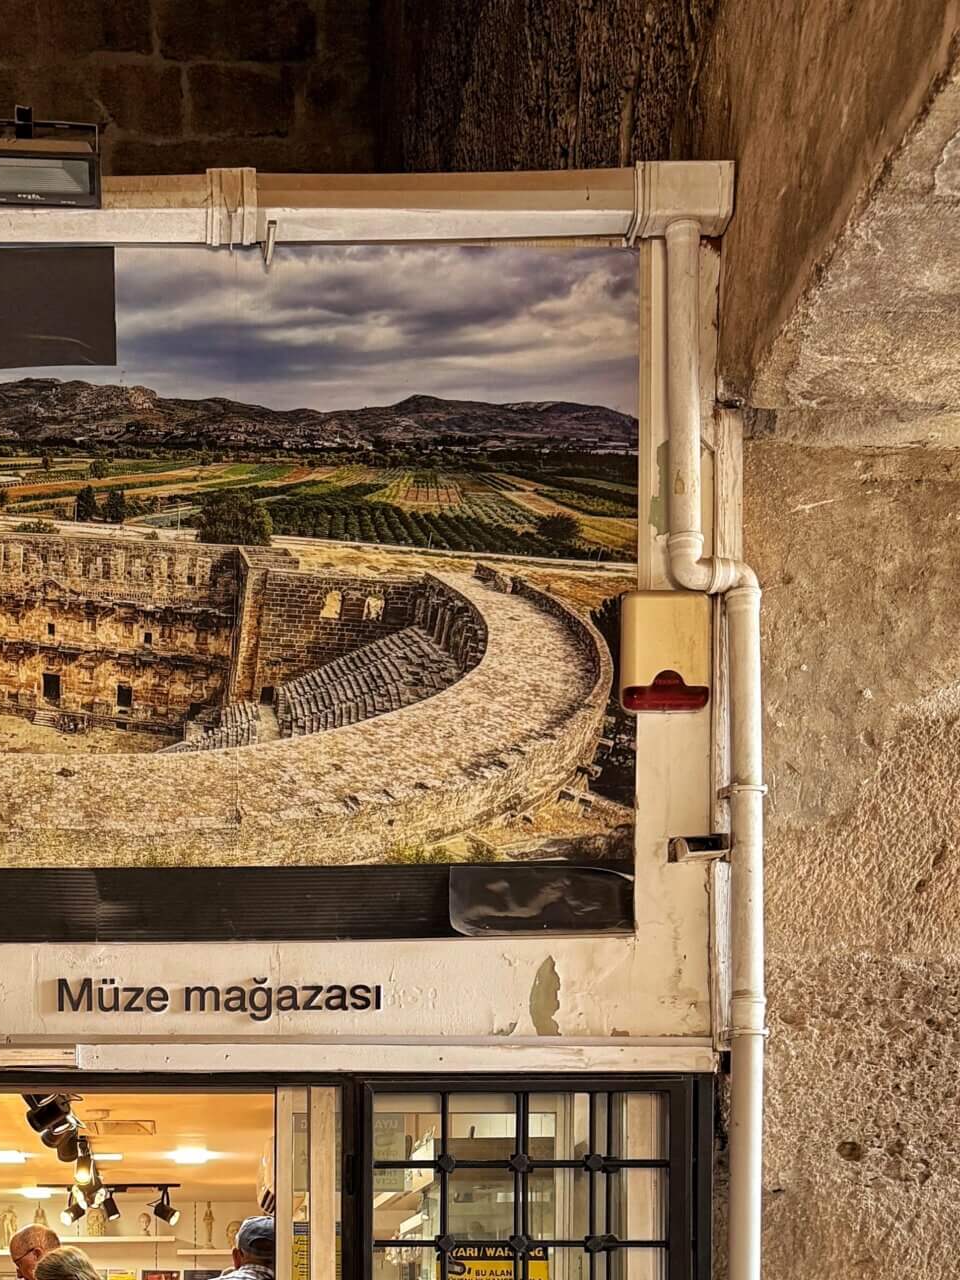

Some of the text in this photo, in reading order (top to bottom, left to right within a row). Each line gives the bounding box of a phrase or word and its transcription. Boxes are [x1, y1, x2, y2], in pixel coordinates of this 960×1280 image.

[57, 976, 382, 1022] Müze mağazası
[448, 1247, 478, 1257] YARI
[485, 1247, 544, 1257] WARNG
[475, 1269, 512, 1277] BU ALAN
